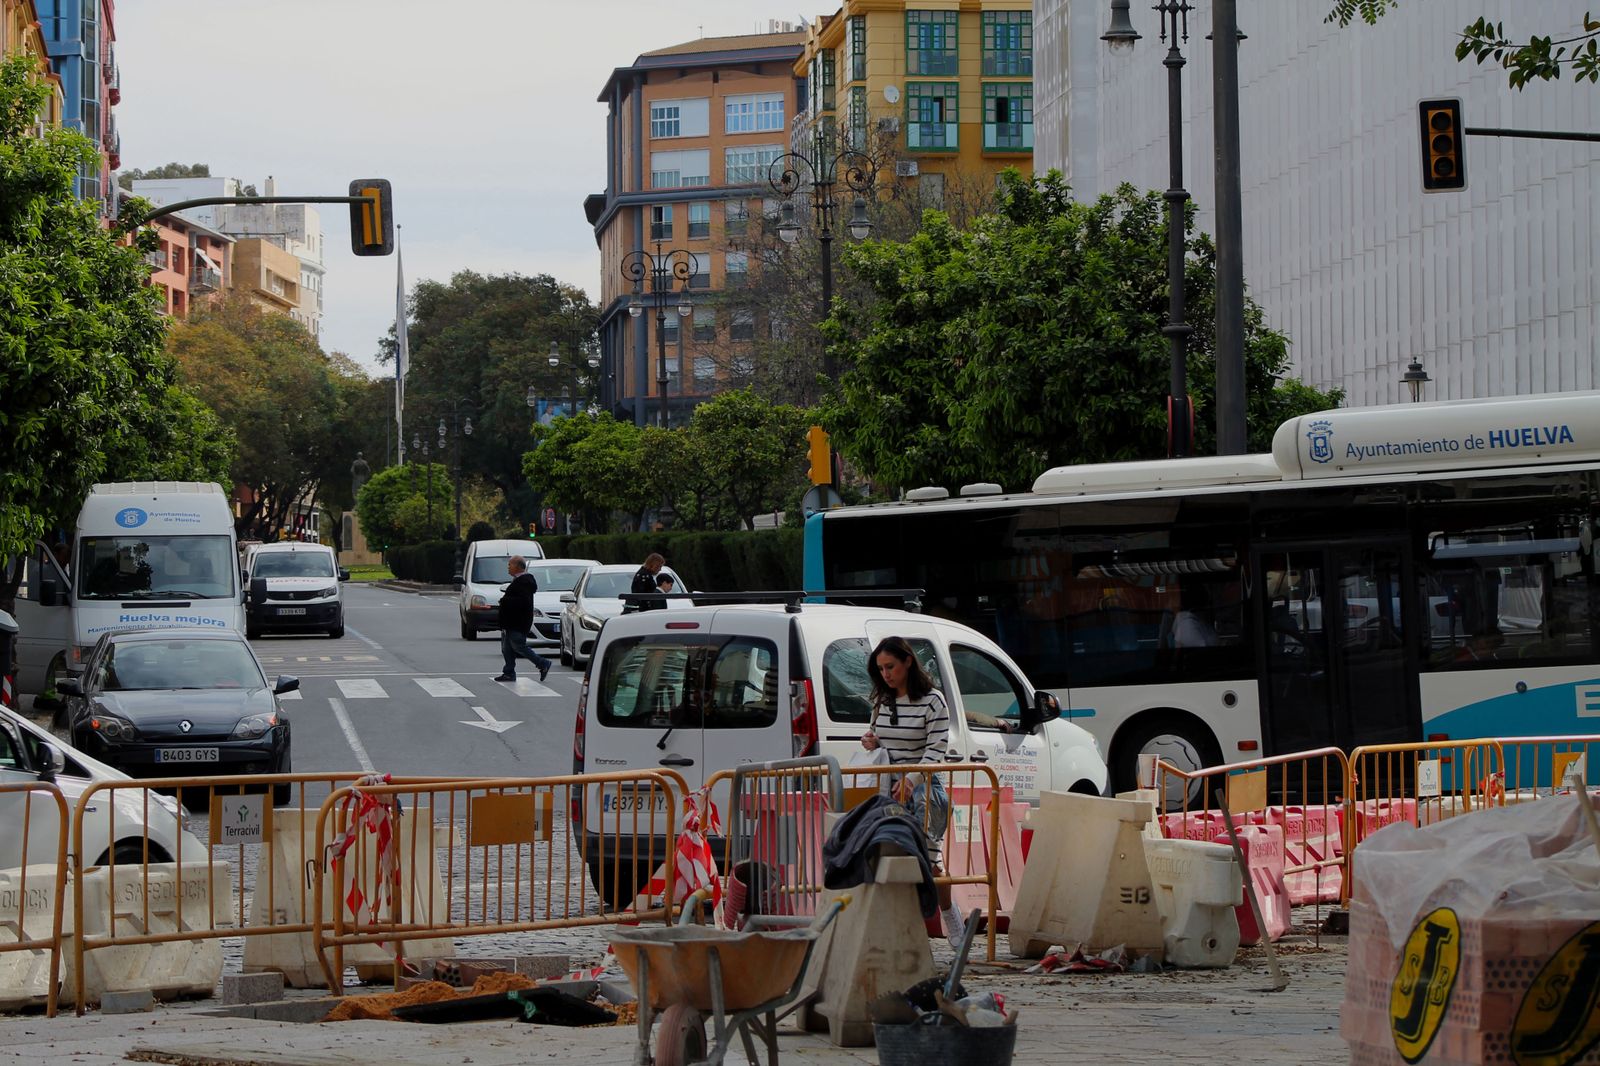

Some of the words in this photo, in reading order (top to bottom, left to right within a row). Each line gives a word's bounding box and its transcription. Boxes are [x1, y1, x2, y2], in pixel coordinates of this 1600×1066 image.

[1346, 438, 1460, 461] Ayuntamiento
[1464, 434, 1485, 450] de
[1489, 425, 1575, 449] HUELVA
[119, 614, 170, 623] Huelva
[175, 616, 226, 627] mejora
[163, 750, 192, 761] 8403
[195, 750, 217, 760] GYS
[612, 796, 643, 810] 6378
[225, 825, 260, 837] Terracivil
